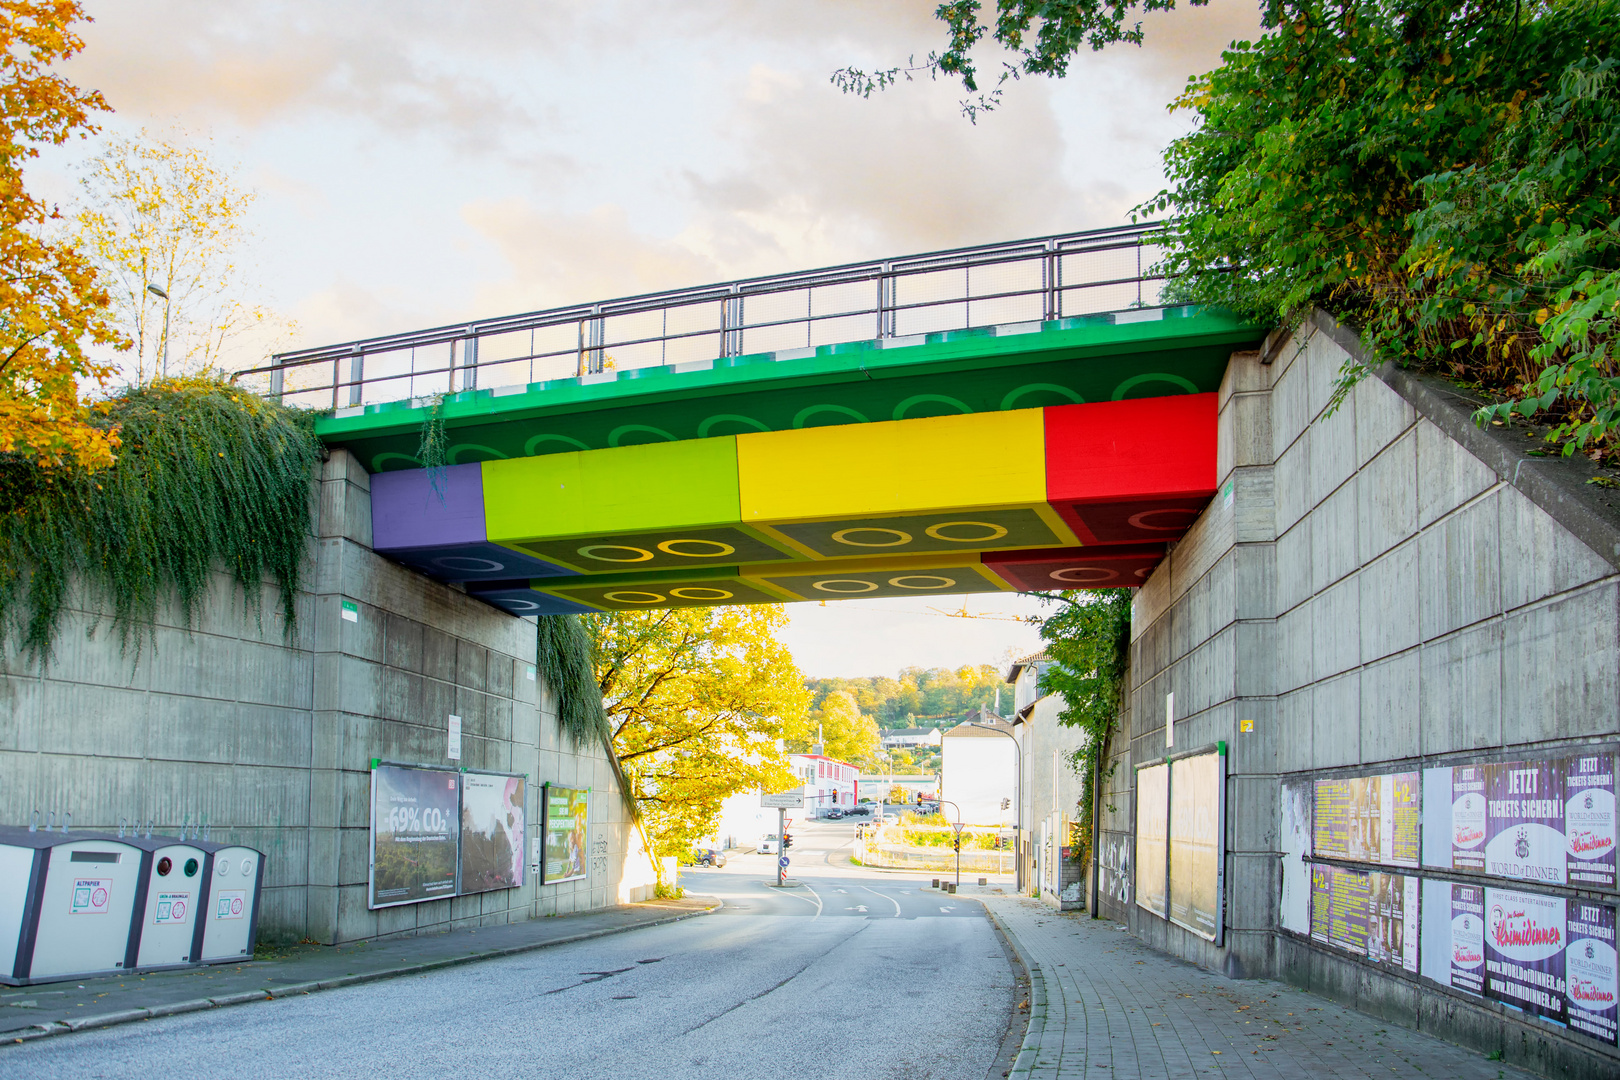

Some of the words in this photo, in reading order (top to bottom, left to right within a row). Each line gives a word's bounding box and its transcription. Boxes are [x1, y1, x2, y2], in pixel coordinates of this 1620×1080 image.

[1580, 757, 1598, 772] JETZT
[1462, 769, 1475, 780] JETZT
[1508, 768, 1538, 794] JETZT
[1567, 776, 1586, 787] TICKETS
[1454, 783, 1467, 792] TICKETS
[1489, 800, 1519, 818] TICKETS
[384, 806, 420, 832] -69%
[549, 819, 575, 828] PERSPEKTIVEN
[1574, 835, 1612, 853] Krimidinner
[1491, 862, 1519, 876] WORLD
[1520, 866, 1525, 876] of
[1525, 865, 1559, 880] DINNER
[1461, 888, 1474, 901] JETZT
[1505, 895, 1518, 903] CLASS
[1519, 897, 1557, 908] ENTERTAINMENT
[1452, 900, 1466, 910] TICKETS
[1513, 910, 1525, 919] Original
[1581, 906, 1600, 922] JETZT
[1497, 918, 1561, 947] Krimidinner
[1568, 920, 1588, 934] TICKETS
[1570, 957, 1588, 968] WORLD
[1591, 962, 1612, 975] DINNER
[1486, 959, 1565, 993] www.WORLDofDINNER.de
[1490, 979, 1561, 1012] www.KRIMIDINNER.de
[1574, 984, 1614, 1002] Krimidinner
